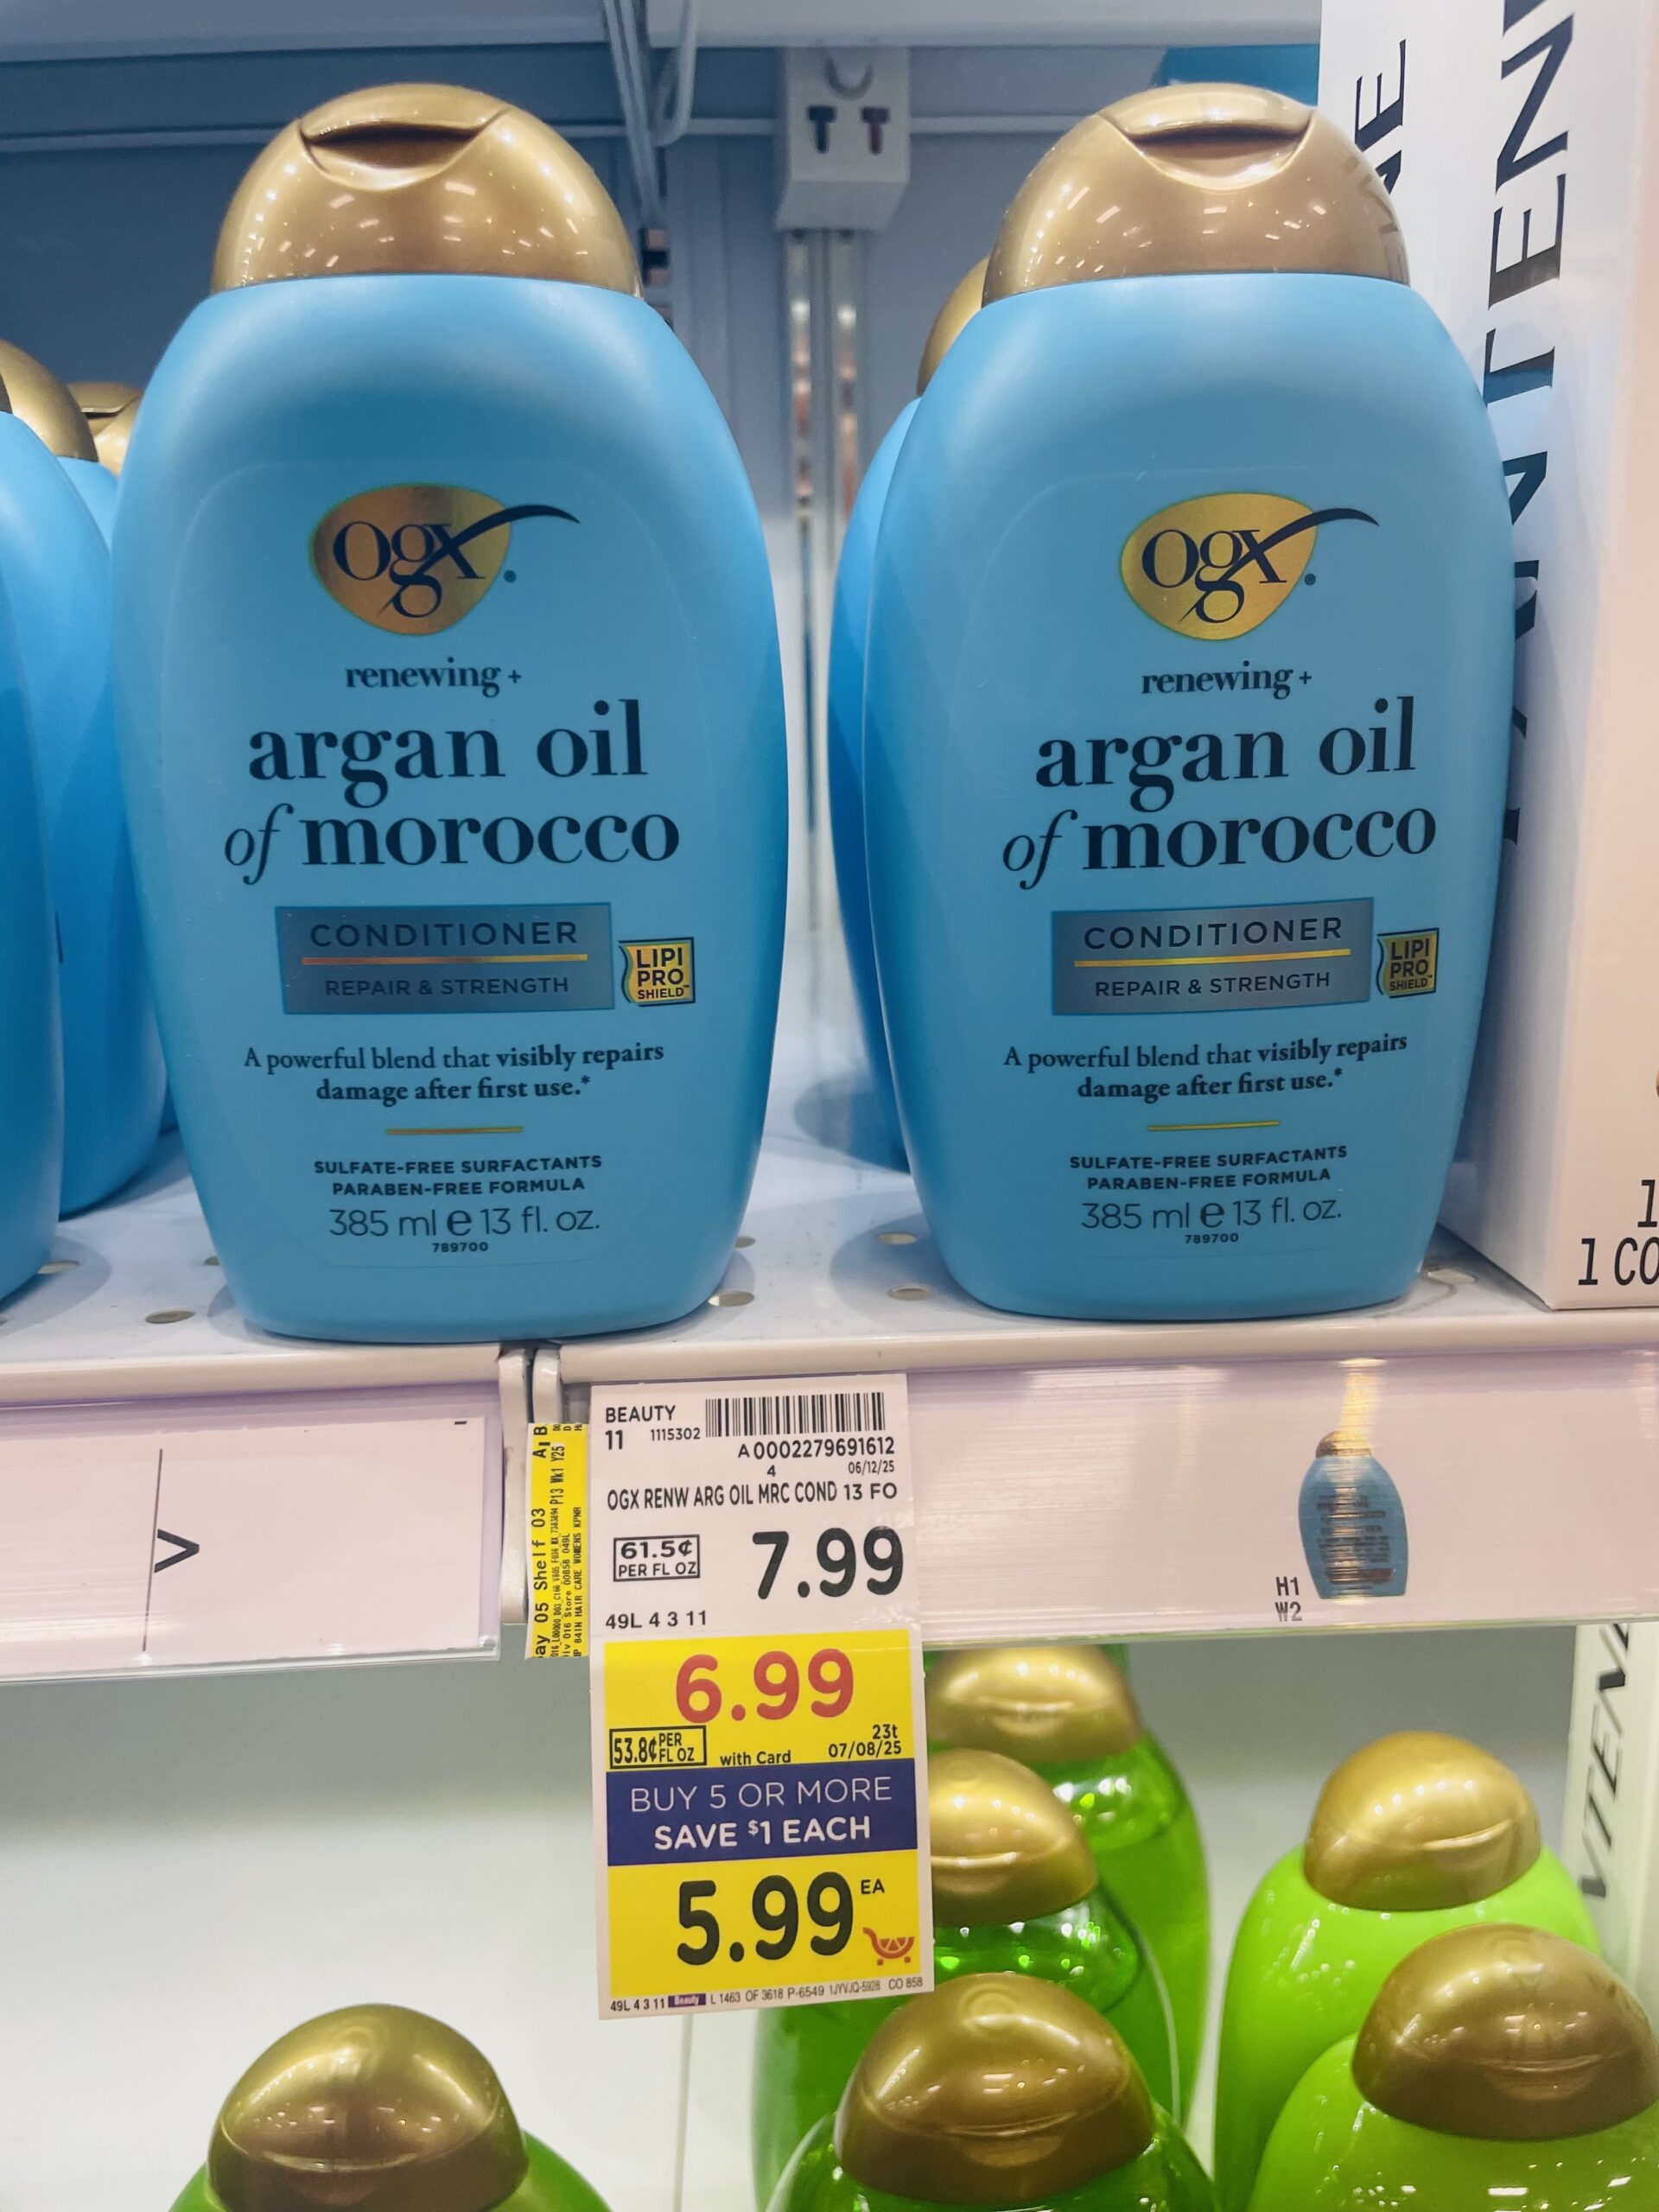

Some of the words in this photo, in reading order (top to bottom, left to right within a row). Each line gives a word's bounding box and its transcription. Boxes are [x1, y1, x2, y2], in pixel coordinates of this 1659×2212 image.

[346, 658, 500, 698] renewing
[1141, 660, 1294, 700] renewing
[249, 728, 506, 809] argan
[537, 699, 648, 778] oil
[1036, 728, 1289, 812] argan
[1319, 696, 1416, 776] oil
[225, 803, 294, 886] of
[299, 814, 680, 866] morocco
[1002, 809, 1078, 890] of
[1082, 807, 1436, 870] morocco
[309, 921, 579, 948] CONDITIONER
[1084, 917, 1343, 950] CONDITIONER
[636, 947, 683, 969] LIPI
[1390, 938, 1431, 961] LIPI
[638, 968, 683, 988] PRO
[1389, 960, 1429, 979] PRO
[325, 980, 410, 996] REPAIR
[419, 979, 433, 995] &
[441, 977, 569, 995] STRENGTH
[1096, 980, 1180, 997] REPAIR
[1188, 978, 1203, 995] &
[1210, 971, 1330, 994] STRENGTH
[244, 1046, 262, 1068] A
[267, 1046, 365, 1075] powerful
[372, 1046, 435, 1069] blend
[443, 1047, 490, 1069] that
[496, 1044, 575, 1071] visibly
[582, 1043, 664, 1071] repairs
[1004, 1046, 1022, 1067] A
[1028, 1046, 1129, 1074] powerful
[1137, 1042, 1200, 1068] blend
[1206, 1043, 1252, 1065] that
[1258, 1038, 1332, 1065] visibly
[1337, 1033, 1408, 1062] repairs
[316, 1079, 409, 1107] damage
[415, 1078, 472, 1101] after
[477, 1077, 528, 1099] first
[1077, 1077, 1171, 1104] damage
[1176, 1075, 1232, 1097] after
[1237, 1072, 1286, 1094] first
[314, 1160, 454, 1175] SULFATE-FREE
[461, 1155, 602, 1173] SURFACTANTS
[1070, 1153, 1211, 1170] SULFATE-FREE
[1217, 1145, 1348, 1167] SURFACTANTS
[332, 1182, 483, 1197] PARABEN-FREE
[489, 1178, 585, 1195] FORMULA
[1087, 1175, 1236, 1191] PARABEN-FREE
[1242, 1168, 1331, 1186] FORMULA
[328, 1209, 388, 1236] 385
[398, 1210, 437, 1236] ml
[480, 1207, 512, 1236] 13
[521, 1205, 549, 1234] fl.
[556, 1209, 601, 1231] oz.
[1081, 1203, 1142, 1230] 385
[1153, 1202, 1190, 1229] ml
[1232, 1199, 1262, 1226] 13
[1272, 1196, 1295, 1224] fl.
[1302, 1198, 1342, 1220] oz.
[431, 1241, 489, 1252] 789700
[1185, 1232, 1239, 1244] 789700
[1578, 1237, 1599, 1286] 1
[605, 1404, 676, 1424] BEAUTY
[605, 1430, 624, 1451] 11
[651, 1427, 702, 1441] 1115302
[550, 1446, 565, 1462] Y25
[550, 1469, 564, 1483] Wk1
[766, 1465, 777, 1478] 4
[848, 1461, 895, 1475] 06/12/25
[550, 1488, 564, 1504] P13
[607, 1489, 640, 1510] OGX
[645, 1486, 690, 1509] RENW
[694, 1485, 725, 1507] ARG
[729, 1484, 754, 1505] OIL
[759, 1483, 791, 1503] MRC
[795, 1481, 837, 1503] COND
[843, 1484, 862, 1501] 13
[870, 1481, 898, 1499] FO
[531, 1508, 545, 1528] 03
[573, 1507, 582, 1528] KPNR
[562, 1534, 570, 1554] 049L
[573, 1533, 582, 1564] WOMENS
[620, 1540, 693, 1560] 61.5¢
[532, 1540, 548, 1591] Shelf
[563, 1559, 571, 1586] 00858
[618, 1563, 647, 1577] PER
[652, 1562, 671, 1576] FL
[675, 1561, 697, 1575] OZ
[752, 1526, 904, 1600] 7.99
[574, 1569, 582, 1590] CARE
[1275, 1577, 1300, 1596] H1
[534, 1602, 549, 1623] 05
[574, 1595, 582, 1618] HAIR
[1274, 1601, 1303, 1622] W2
[605, 1611, 642, 1630] 49L
[649, 1612, 660, 1628] 4
[667, 1611, 678, 1627] 3
[687, 1611, 707, 1626] 11
[532, 1635, 550, 1658] ay
[676, 1648, 854, 1724] 6.99
[658, 1732, 682, 1746] PER
[872, 1724, 898, 1740] 23t
[613, 1736, 657, 1764] 53.8¢
[659, 1748, 674, 1763] FL
[677, 1747, 695, 1762] OZ
[720, 1752, 752, 1766] with
[756, 1751, 791, 1765] Card
[828, 1740, 902, 1758] 07/08/25
[631, 1786, 697, 1812] BUY
[709, 1785, 727, 1808] 5
[739, 1783, 785, 1808] OR
[798, 1777, 893, 1804] MORE
[654, 1822, 737, 1851] SAVE
[747, 1820, 771, 1845] $1
[784, 1816, 870, 1844] EACH
[860, 1878, 886, 1895] EA
[677, 1872, 854, 1966] 5.99
[610, 2000, 631, 2012] 49L
[633, 1999, 639, 2010] 4
[643, 1999, 650, 2010] 3
[653, 1998, 664, 2009] 11
[710, 1993, 716, 2005] L
[720, 1992, 741, 2004] 1463
[745, 1989, 759, 2002] OF
[761, 1988, 784, 2000] 3618
[787, 1986, 824, 1999] P-6549
[888, 1978, 903, 1990] CO
[906, 1976, 923, 1988] 858
